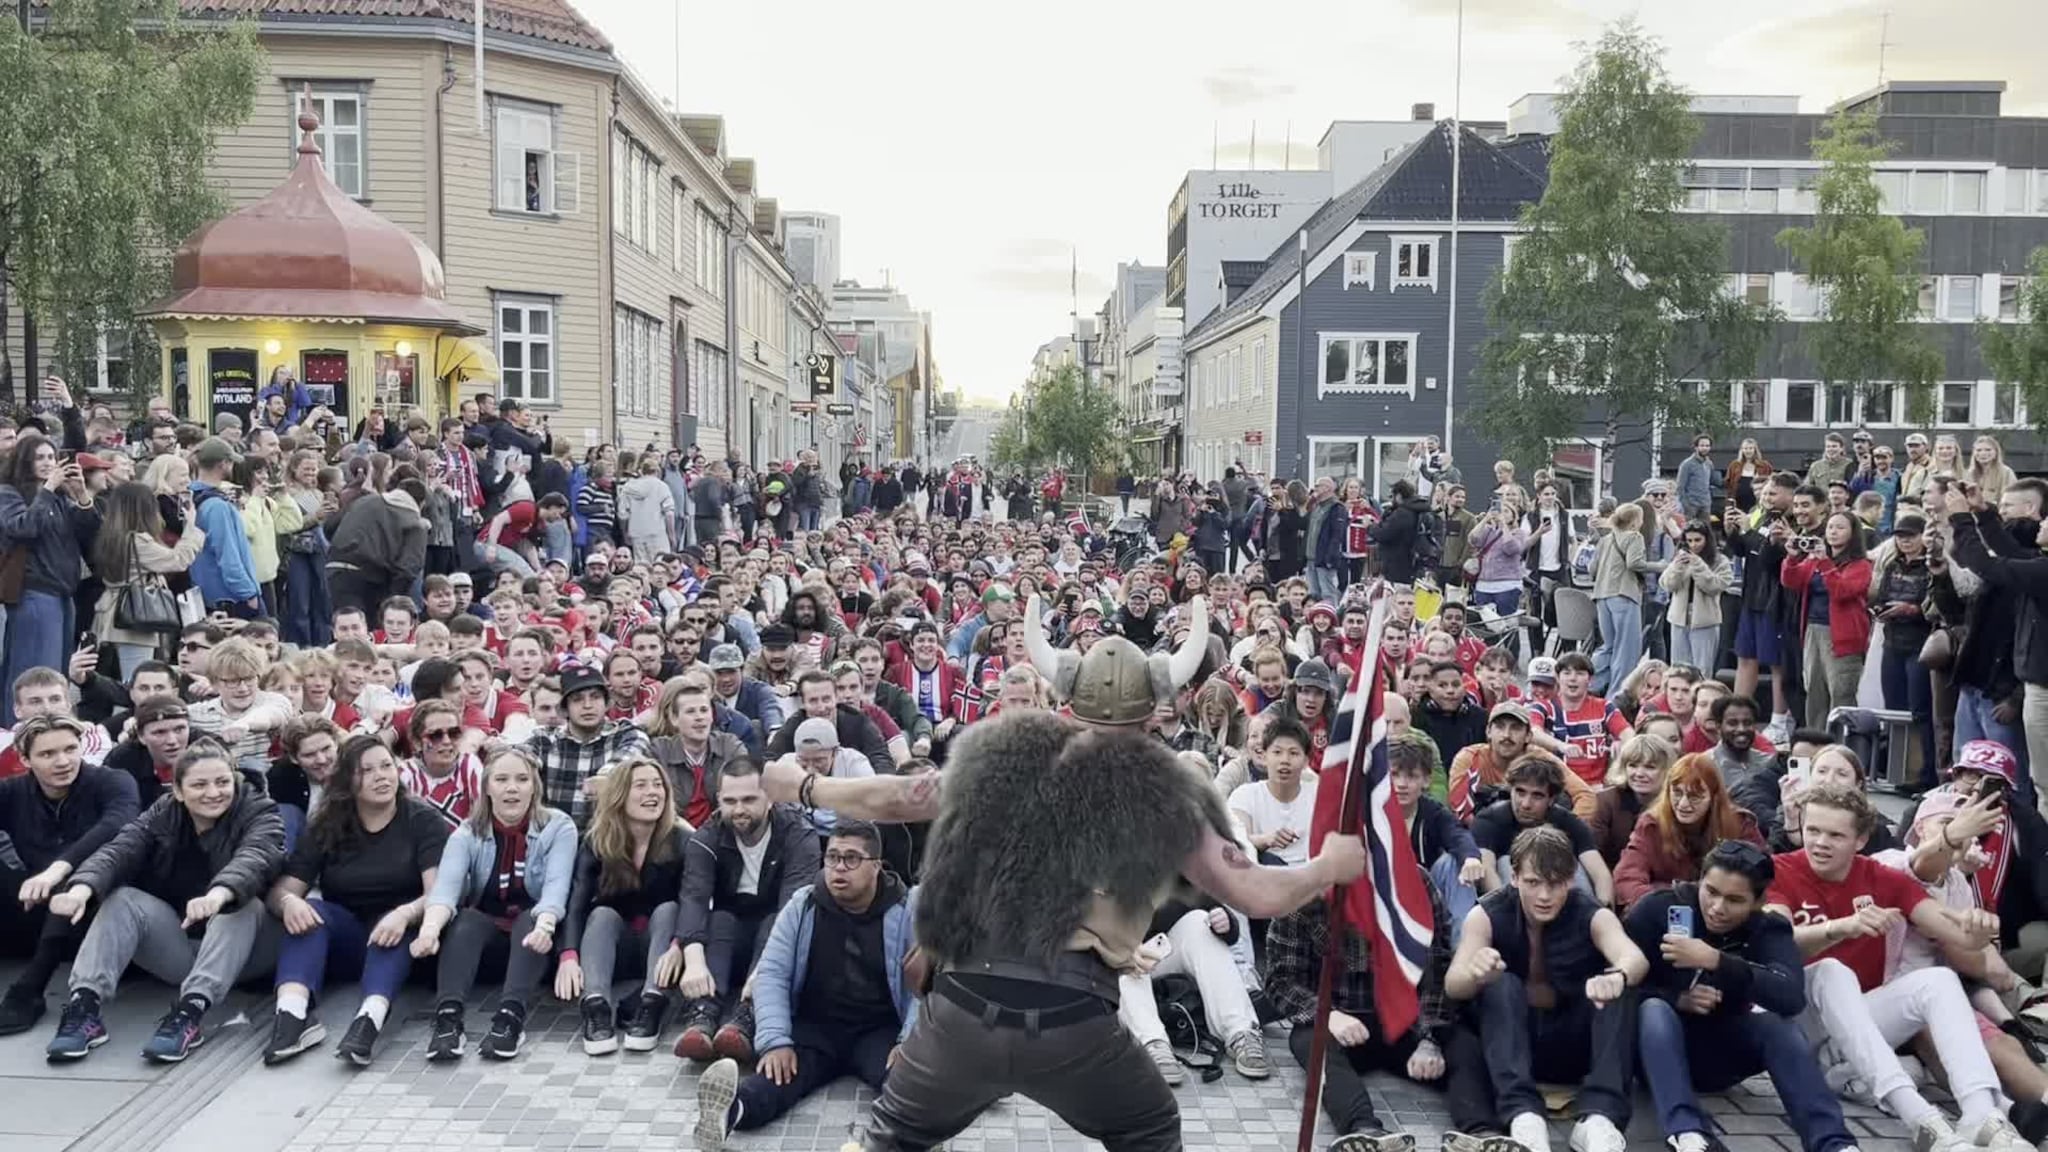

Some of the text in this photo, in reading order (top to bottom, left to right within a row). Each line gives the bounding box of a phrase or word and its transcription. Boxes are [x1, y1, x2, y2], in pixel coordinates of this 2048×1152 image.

[1218, 183, 1260, 199] Lille
[1199, 203, 1281, 218] TORGET
[213, 394, 253, 404] MYDLAND
